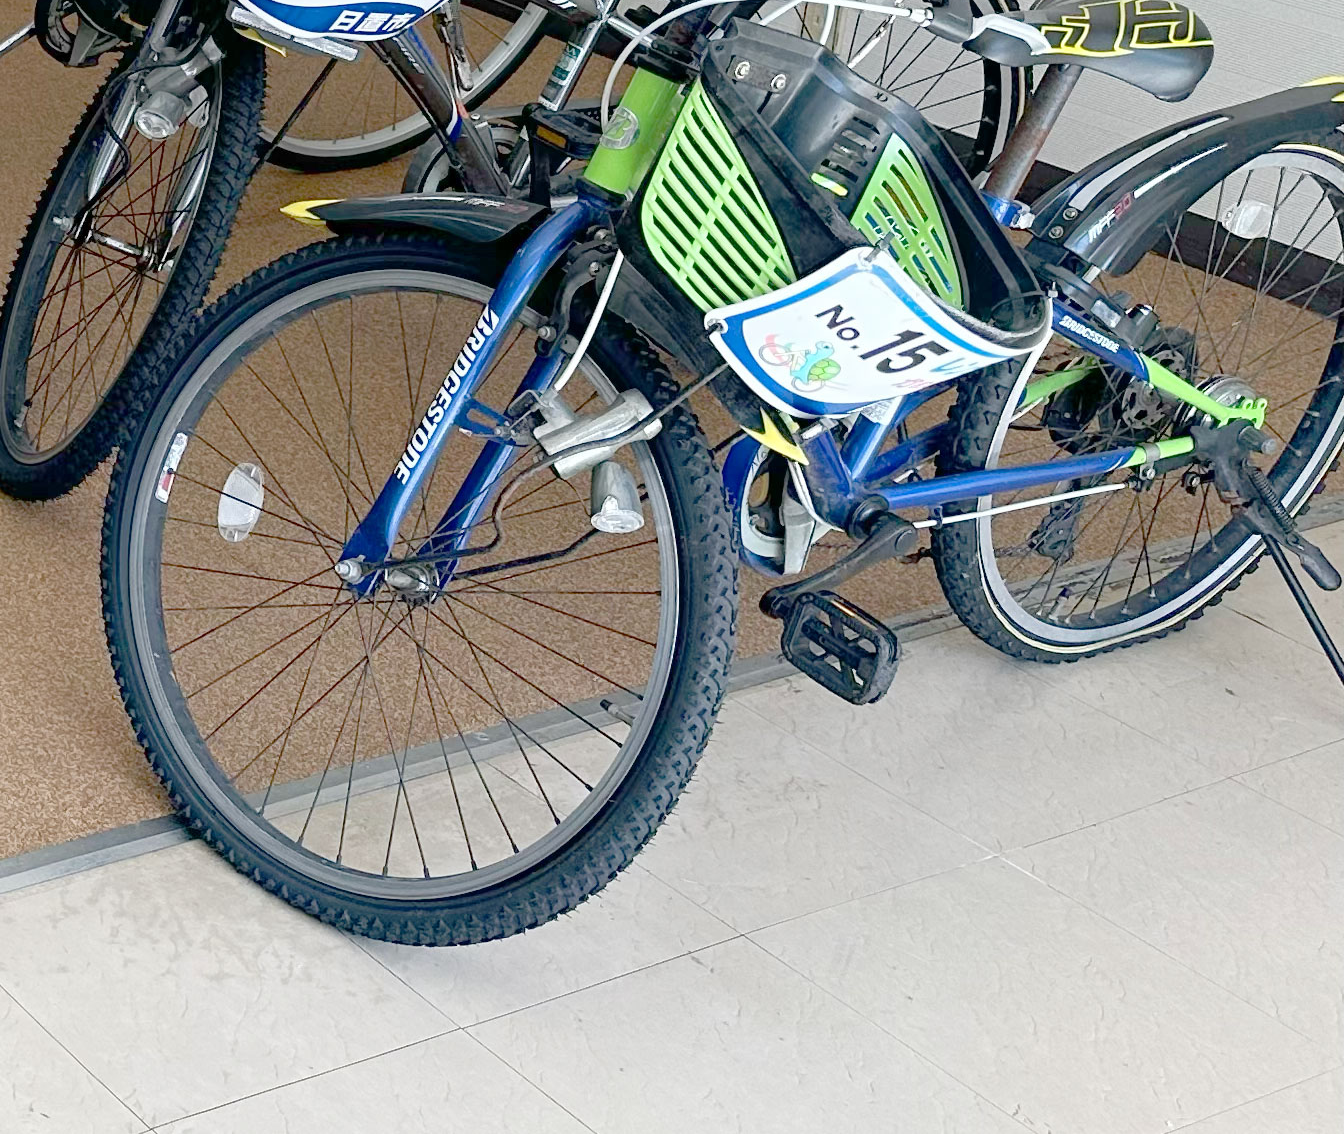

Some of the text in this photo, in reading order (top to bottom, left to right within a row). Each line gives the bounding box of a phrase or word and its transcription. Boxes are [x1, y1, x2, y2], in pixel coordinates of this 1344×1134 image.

[328, 9, 417, 33] 日置市
[1058, 315, 1120, 354] BRIDGESTONE
[393, 303, 501, 485] BRIDGESTONE
